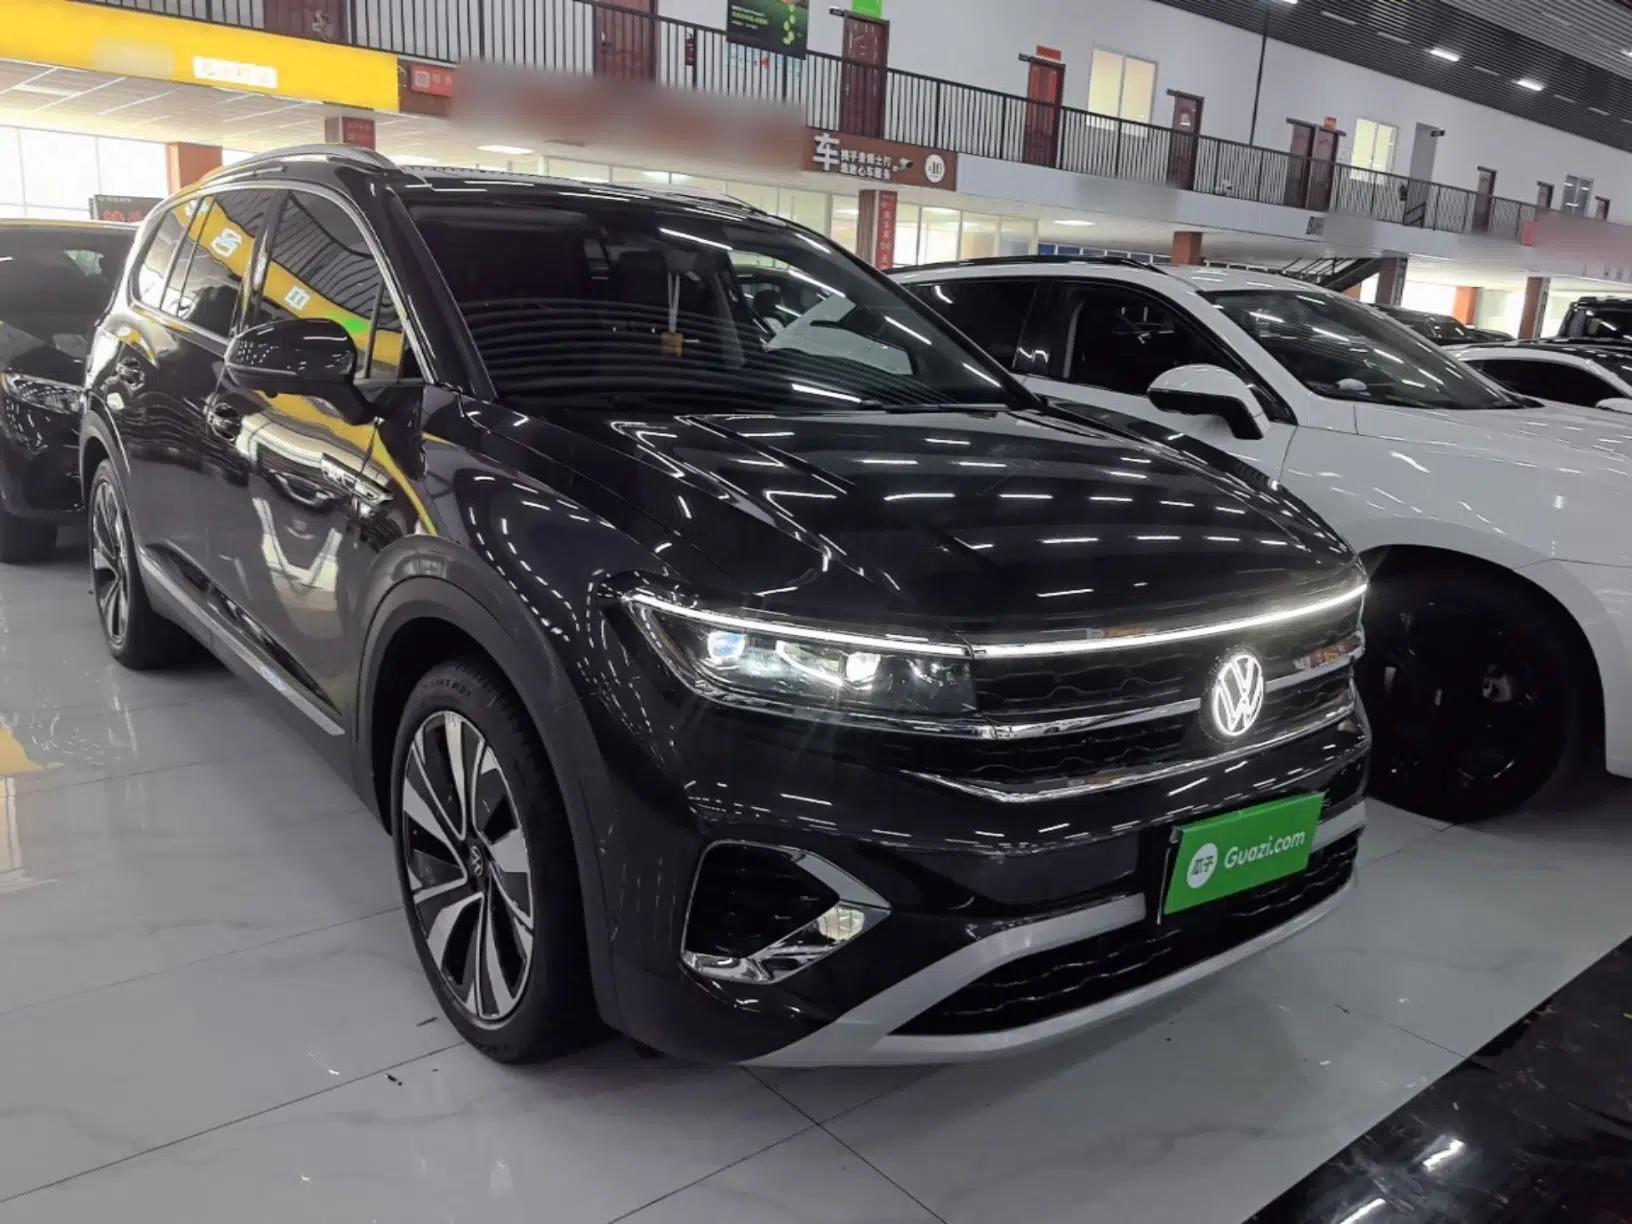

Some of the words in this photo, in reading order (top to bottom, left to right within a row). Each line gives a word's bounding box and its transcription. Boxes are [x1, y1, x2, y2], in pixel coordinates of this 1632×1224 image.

[812, 132, 841, 172] 车
[1212, 654, 1264, 737] VW
[1224, 831, 1306, 868] Guazi.com
